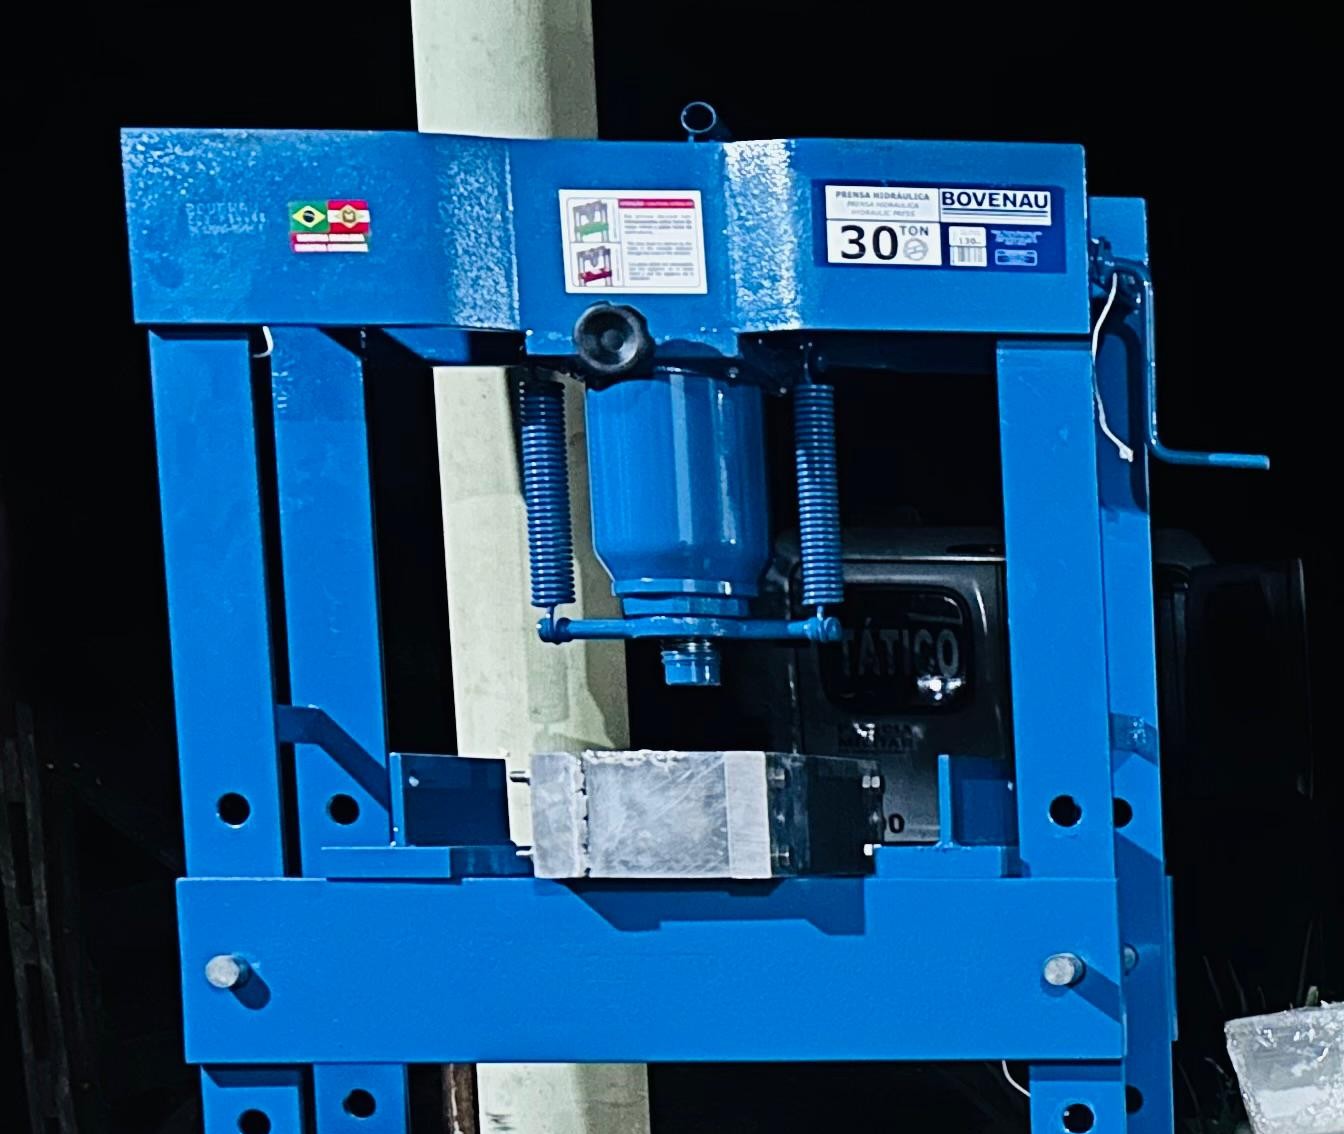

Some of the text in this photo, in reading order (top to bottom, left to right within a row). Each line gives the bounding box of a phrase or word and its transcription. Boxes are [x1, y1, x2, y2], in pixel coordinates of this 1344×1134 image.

[836, 191, 929, 200] PRENSA HIDRÁULICA
[942, 192, 1048, 209] BOVENAU
[899, 226, 929, 236] TON
[841, 225, 898, 260] 30
[842, 617, 959, 677] TÁTICO
